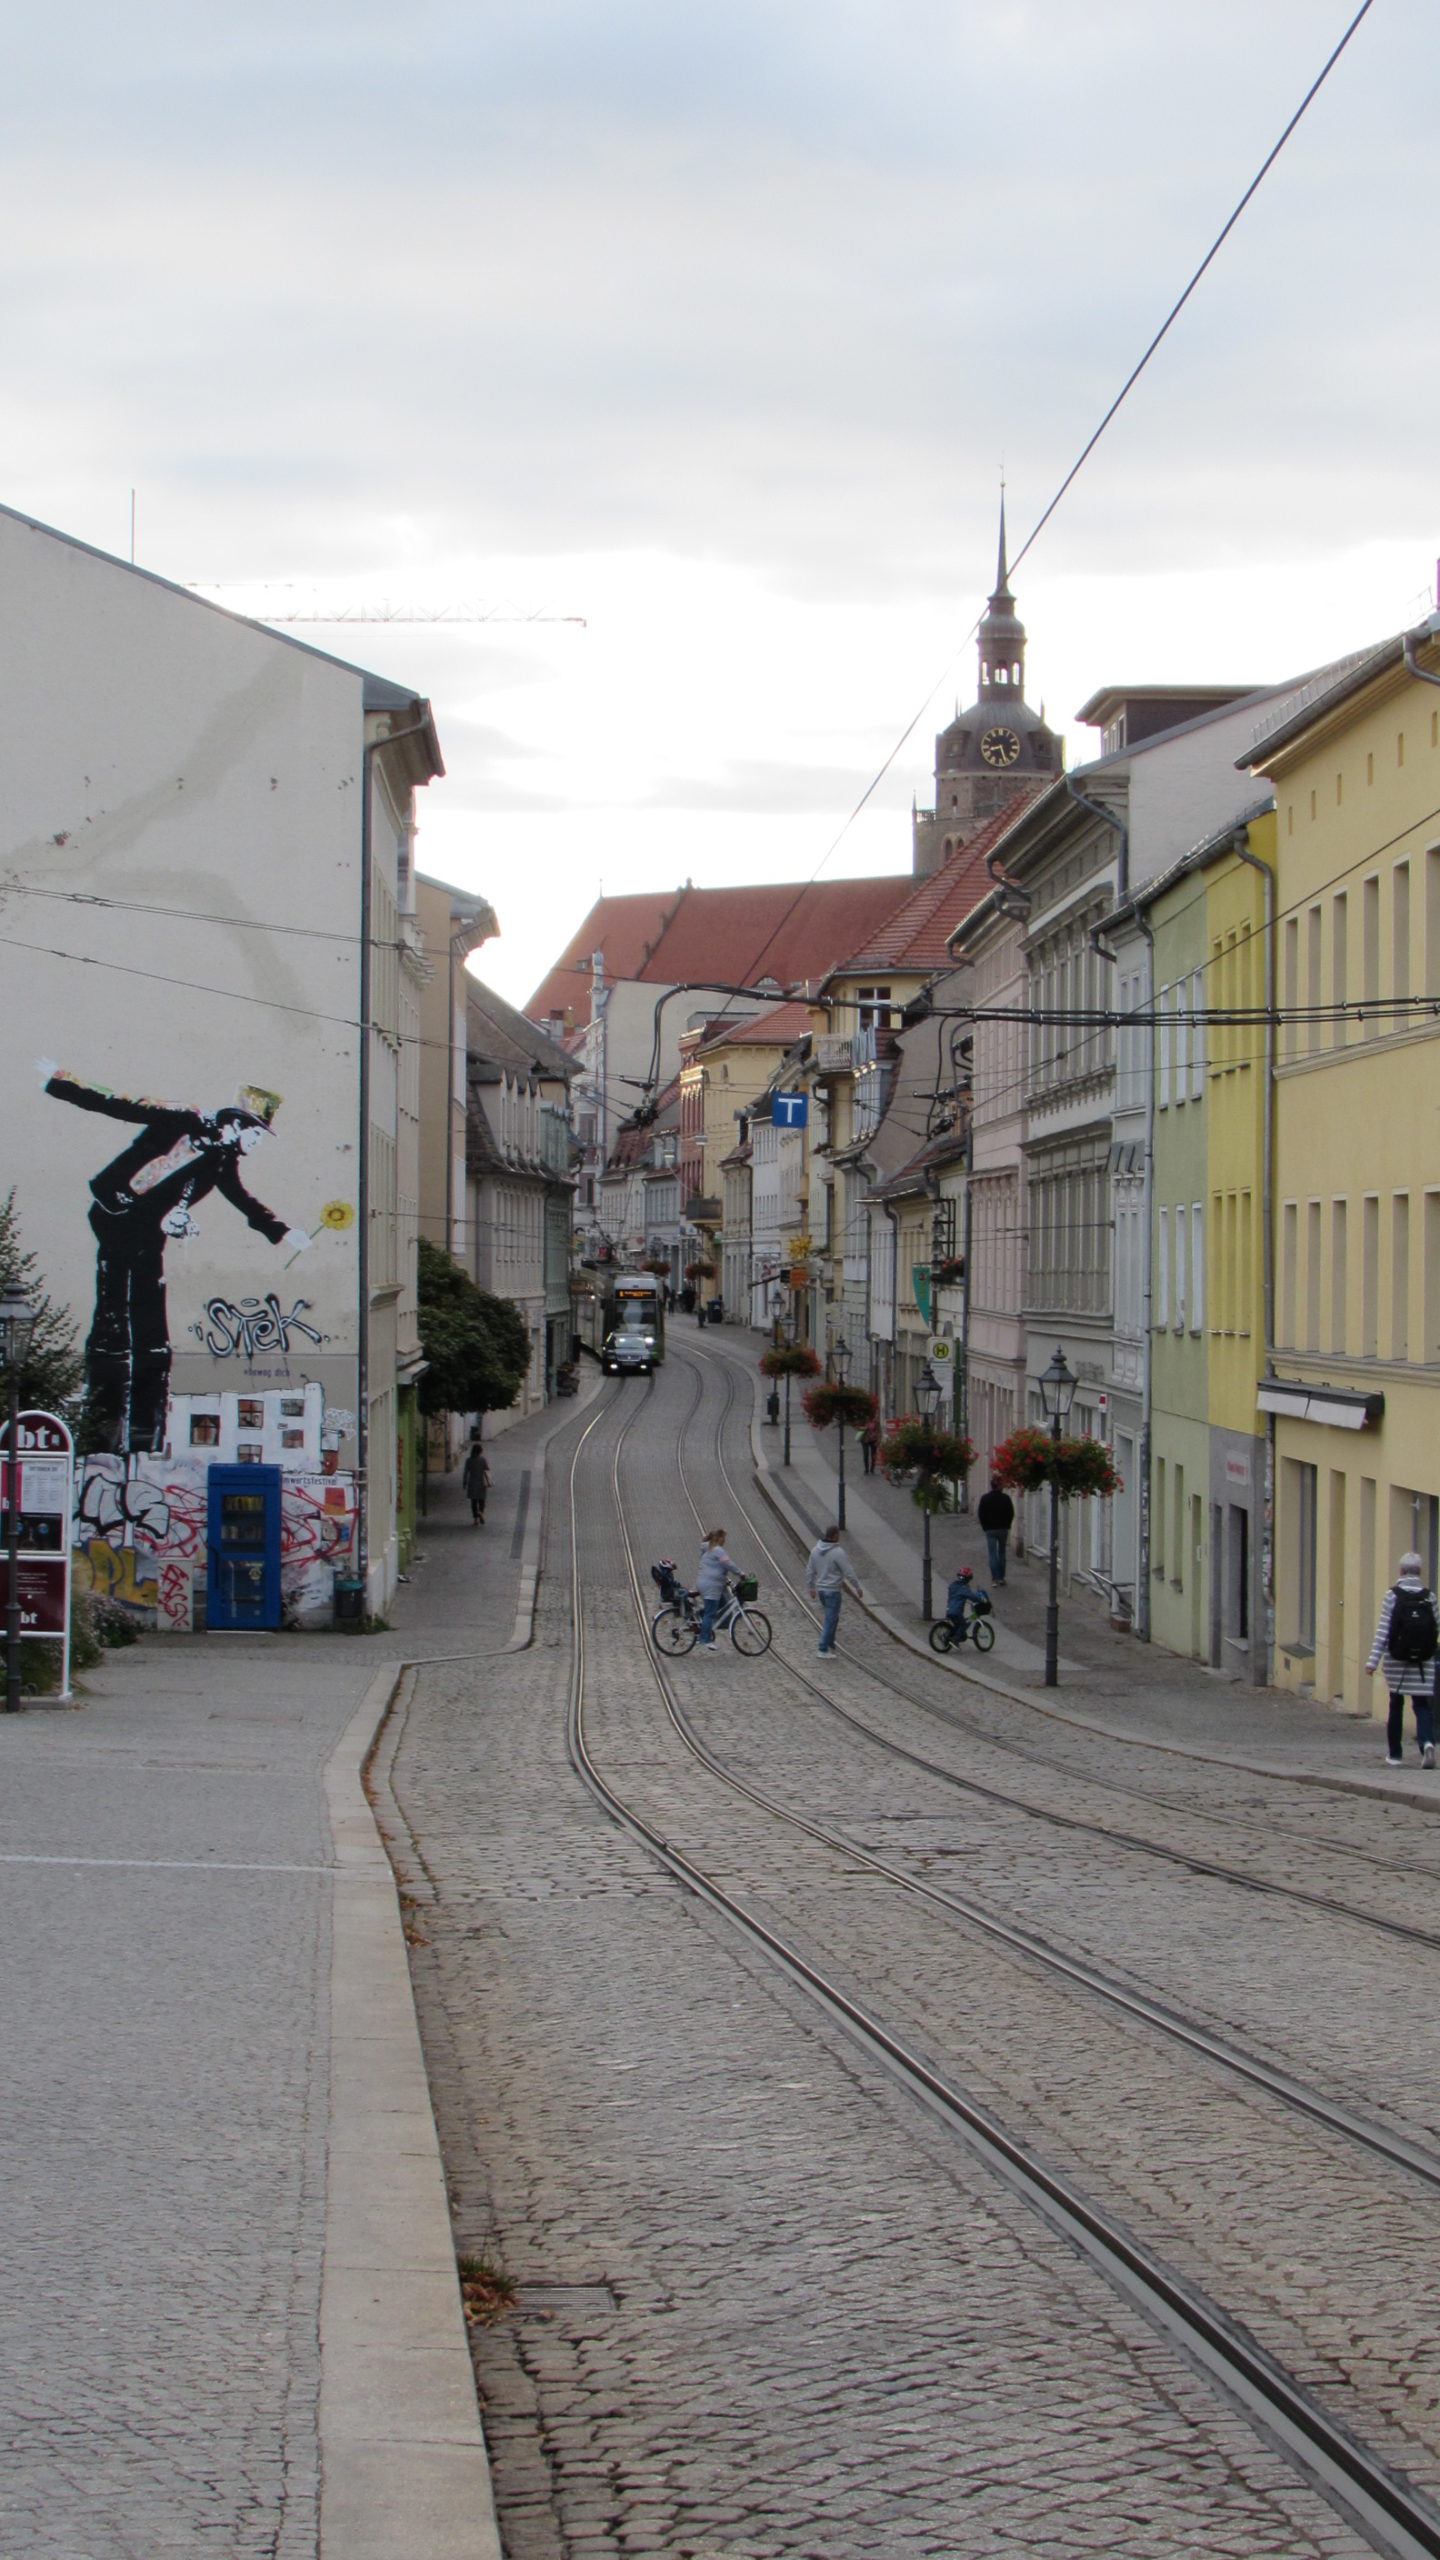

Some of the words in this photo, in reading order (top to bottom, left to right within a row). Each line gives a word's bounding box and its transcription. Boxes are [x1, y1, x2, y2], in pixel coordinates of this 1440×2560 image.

[778, 1098, 803, 1123] T
[17, 1424, 50, 1449] bt
[20, 1611, 38, 1624] bt
